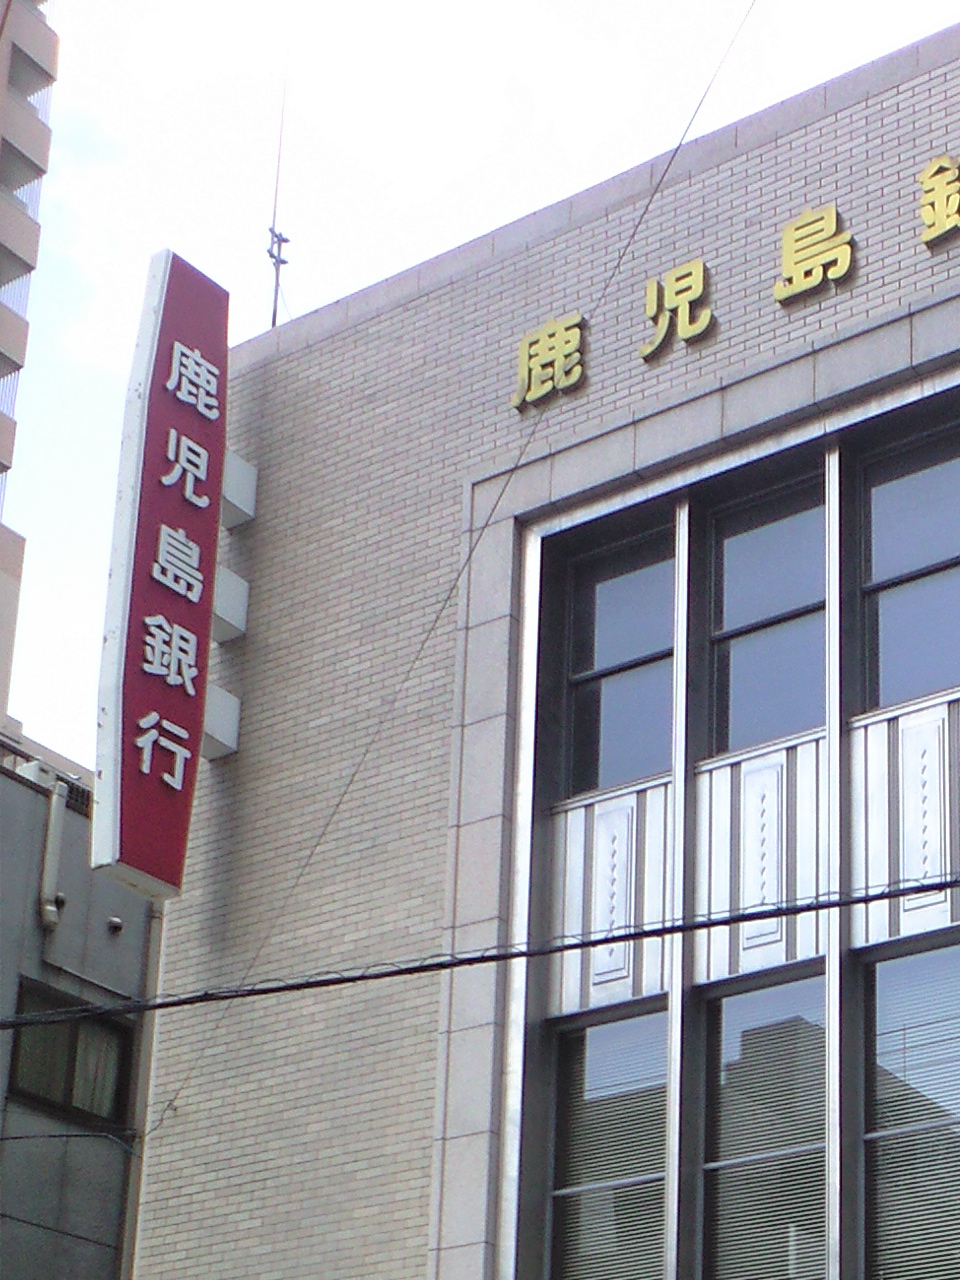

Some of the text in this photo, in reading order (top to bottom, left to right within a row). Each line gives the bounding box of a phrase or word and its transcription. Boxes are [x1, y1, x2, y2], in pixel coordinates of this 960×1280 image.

[136, 341, 220, 791] 鹿児島銀行
